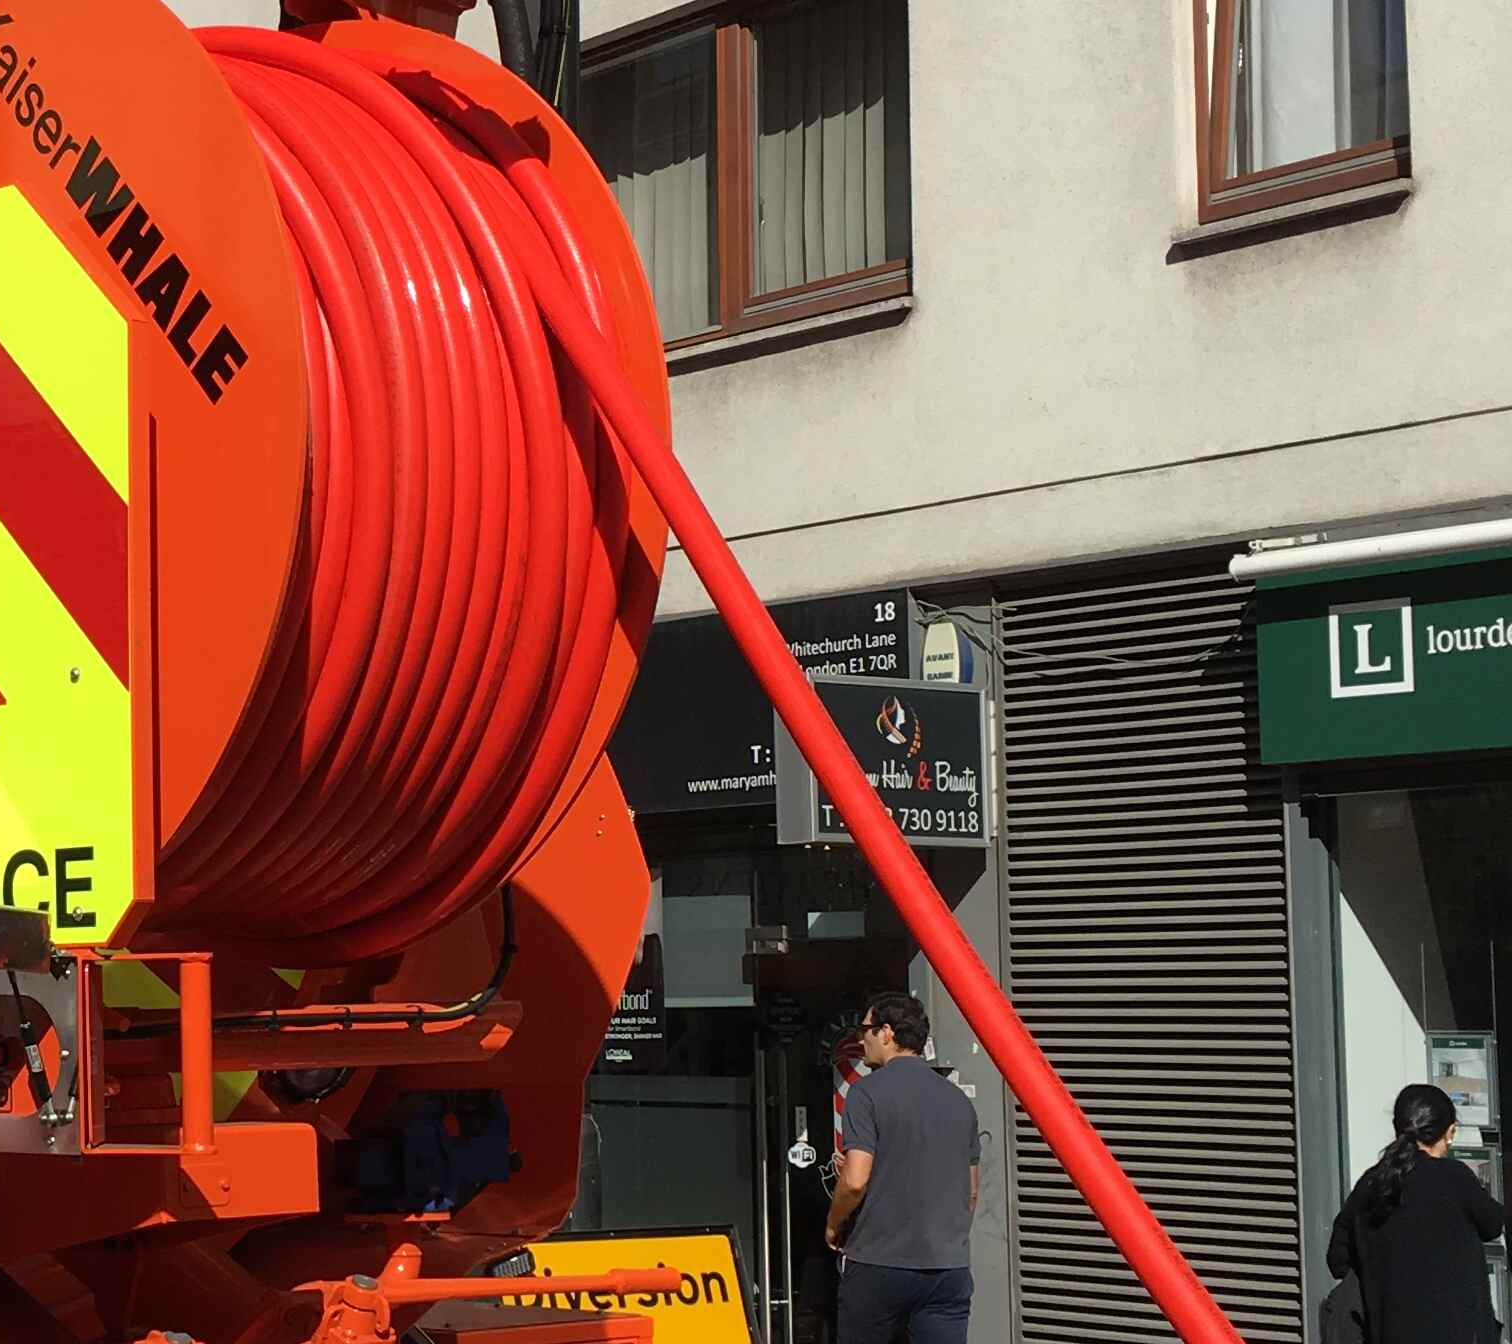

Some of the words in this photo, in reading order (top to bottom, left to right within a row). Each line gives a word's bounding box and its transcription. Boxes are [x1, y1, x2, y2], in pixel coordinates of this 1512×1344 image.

[874, 601, 896, 623] 18
[865, 633, 896, 648] Lane
[1353, 623, 1392, 674] L
[799, 660, 847, 676] ondon
[849, 657, 866, 674] E1
[869, 653, 897, 671] 7QR
[688, 771, 776, 793] www.maryamh
[882, 759, 913, 789] Hair
[918, 761, 932, 790] &
[935, 761, 980, 808] Beauty
[899, 808, 931, 831] 730
[936, 810, 979, 833] 9118
[513, 1262, 729, 1311] iveion
